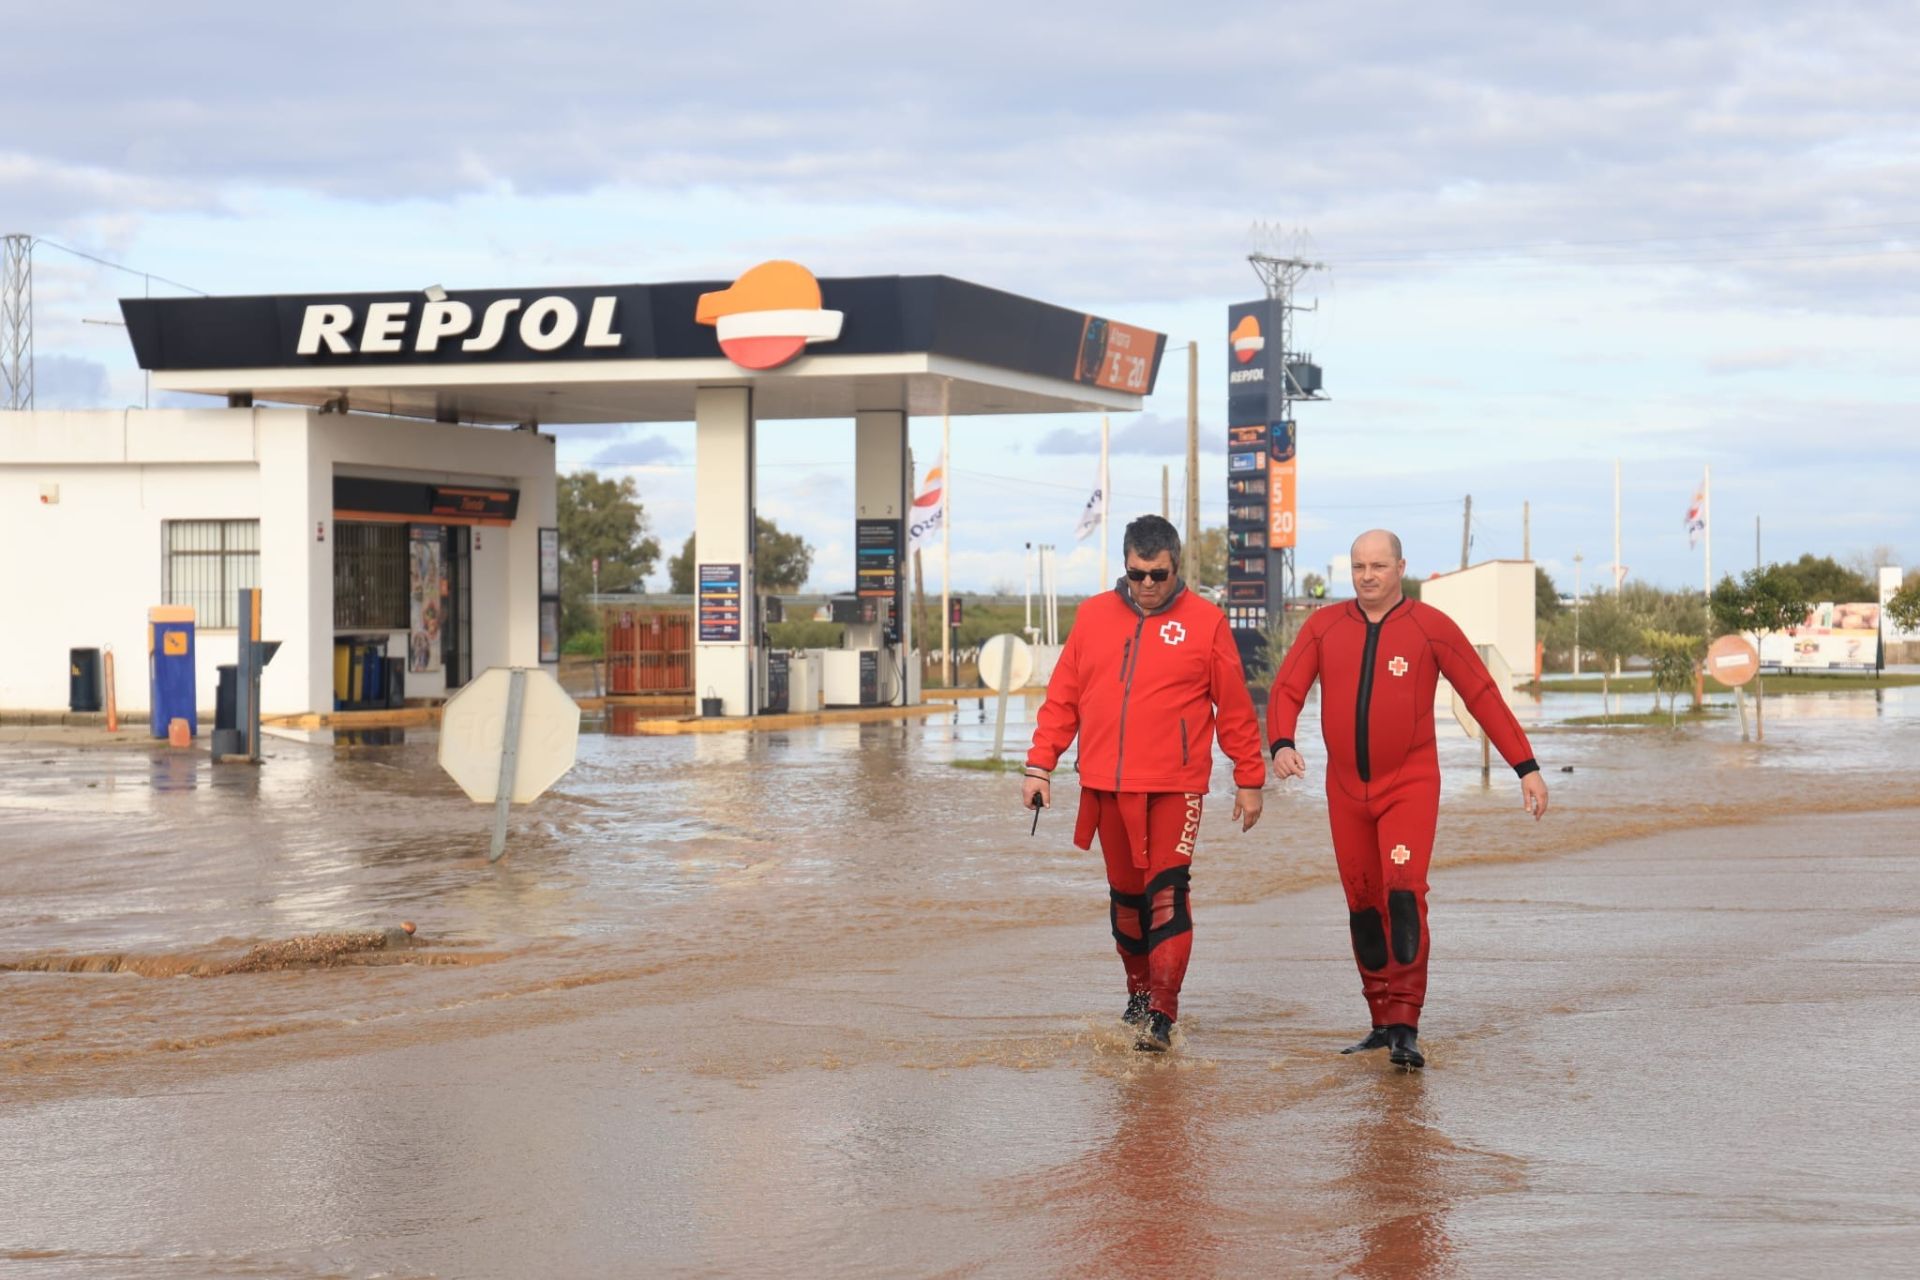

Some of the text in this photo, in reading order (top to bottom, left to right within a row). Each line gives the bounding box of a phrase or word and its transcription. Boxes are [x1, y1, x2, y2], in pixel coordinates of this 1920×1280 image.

[296, 295, 623, 355] REPSOL
[1127, 355, 1146, 388] 20
[1229, 368, 1264, 384] REPSOL
[1272, 482, 1282, 505] 5
[1273, 511, 1293, 534] 20
[888, 555, 895, 564] 5
[883, 576, 895, 585] 10
